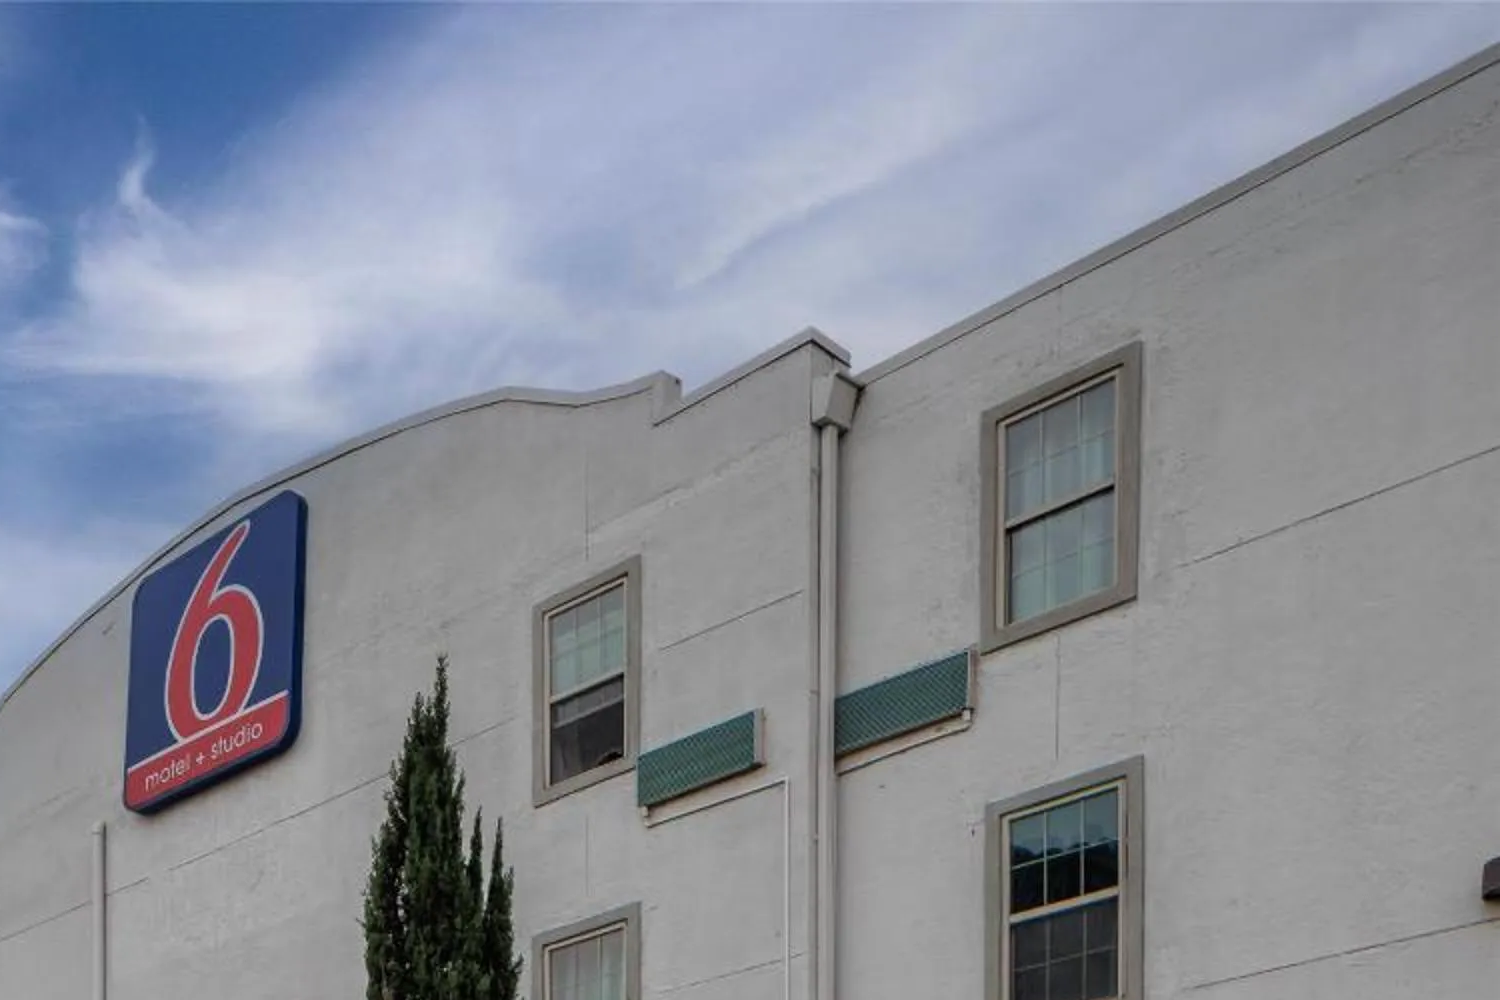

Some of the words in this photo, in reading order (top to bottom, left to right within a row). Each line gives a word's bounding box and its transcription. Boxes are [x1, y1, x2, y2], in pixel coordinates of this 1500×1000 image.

[164, 519, 264, 743] 6
[144, 753, 191, 792] motel
[211, 722, 263, 760] studio
